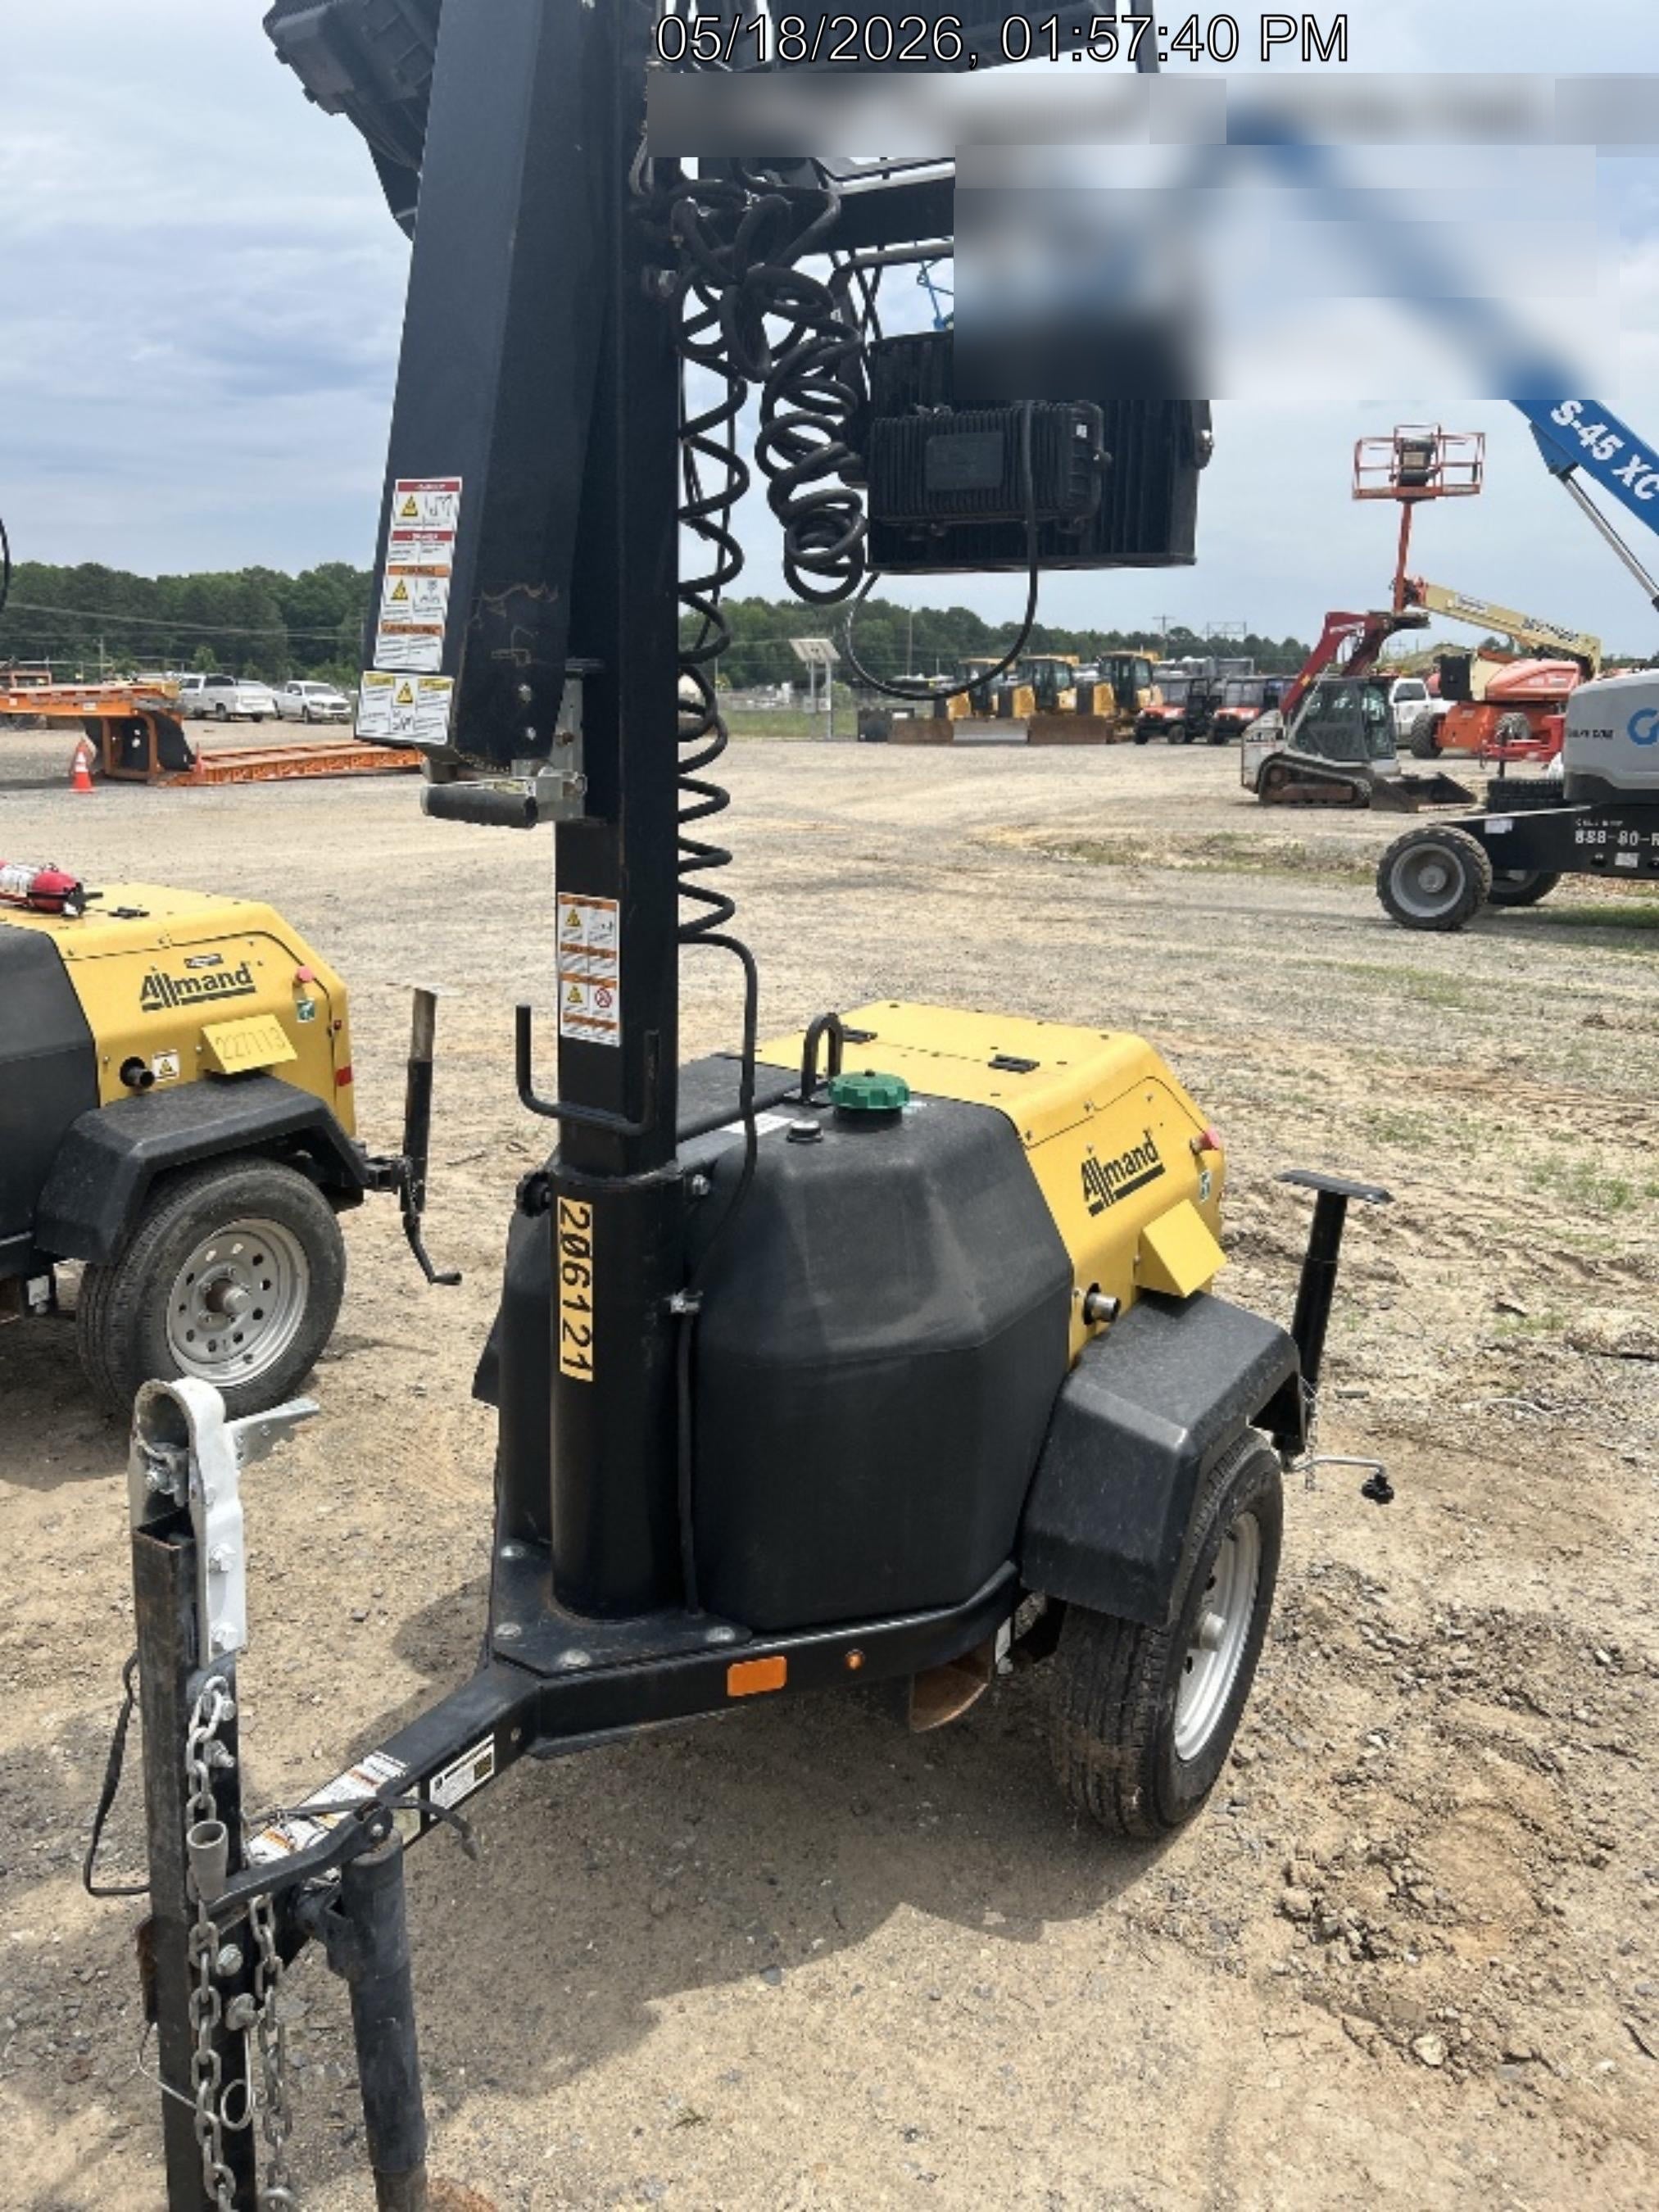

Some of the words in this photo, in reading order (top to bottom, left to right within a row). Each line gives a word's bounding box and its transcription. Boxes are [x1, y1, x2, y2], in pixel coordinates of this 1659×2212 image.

[1551, 400, 1625, 460] S-45
[1612, 454, 1659, 500] XC
[139, 961, 255, 1009] Allmand
[1081, 1128, 1162, 1210] Allmand
[560, 1200, 592, 1371] 206121
